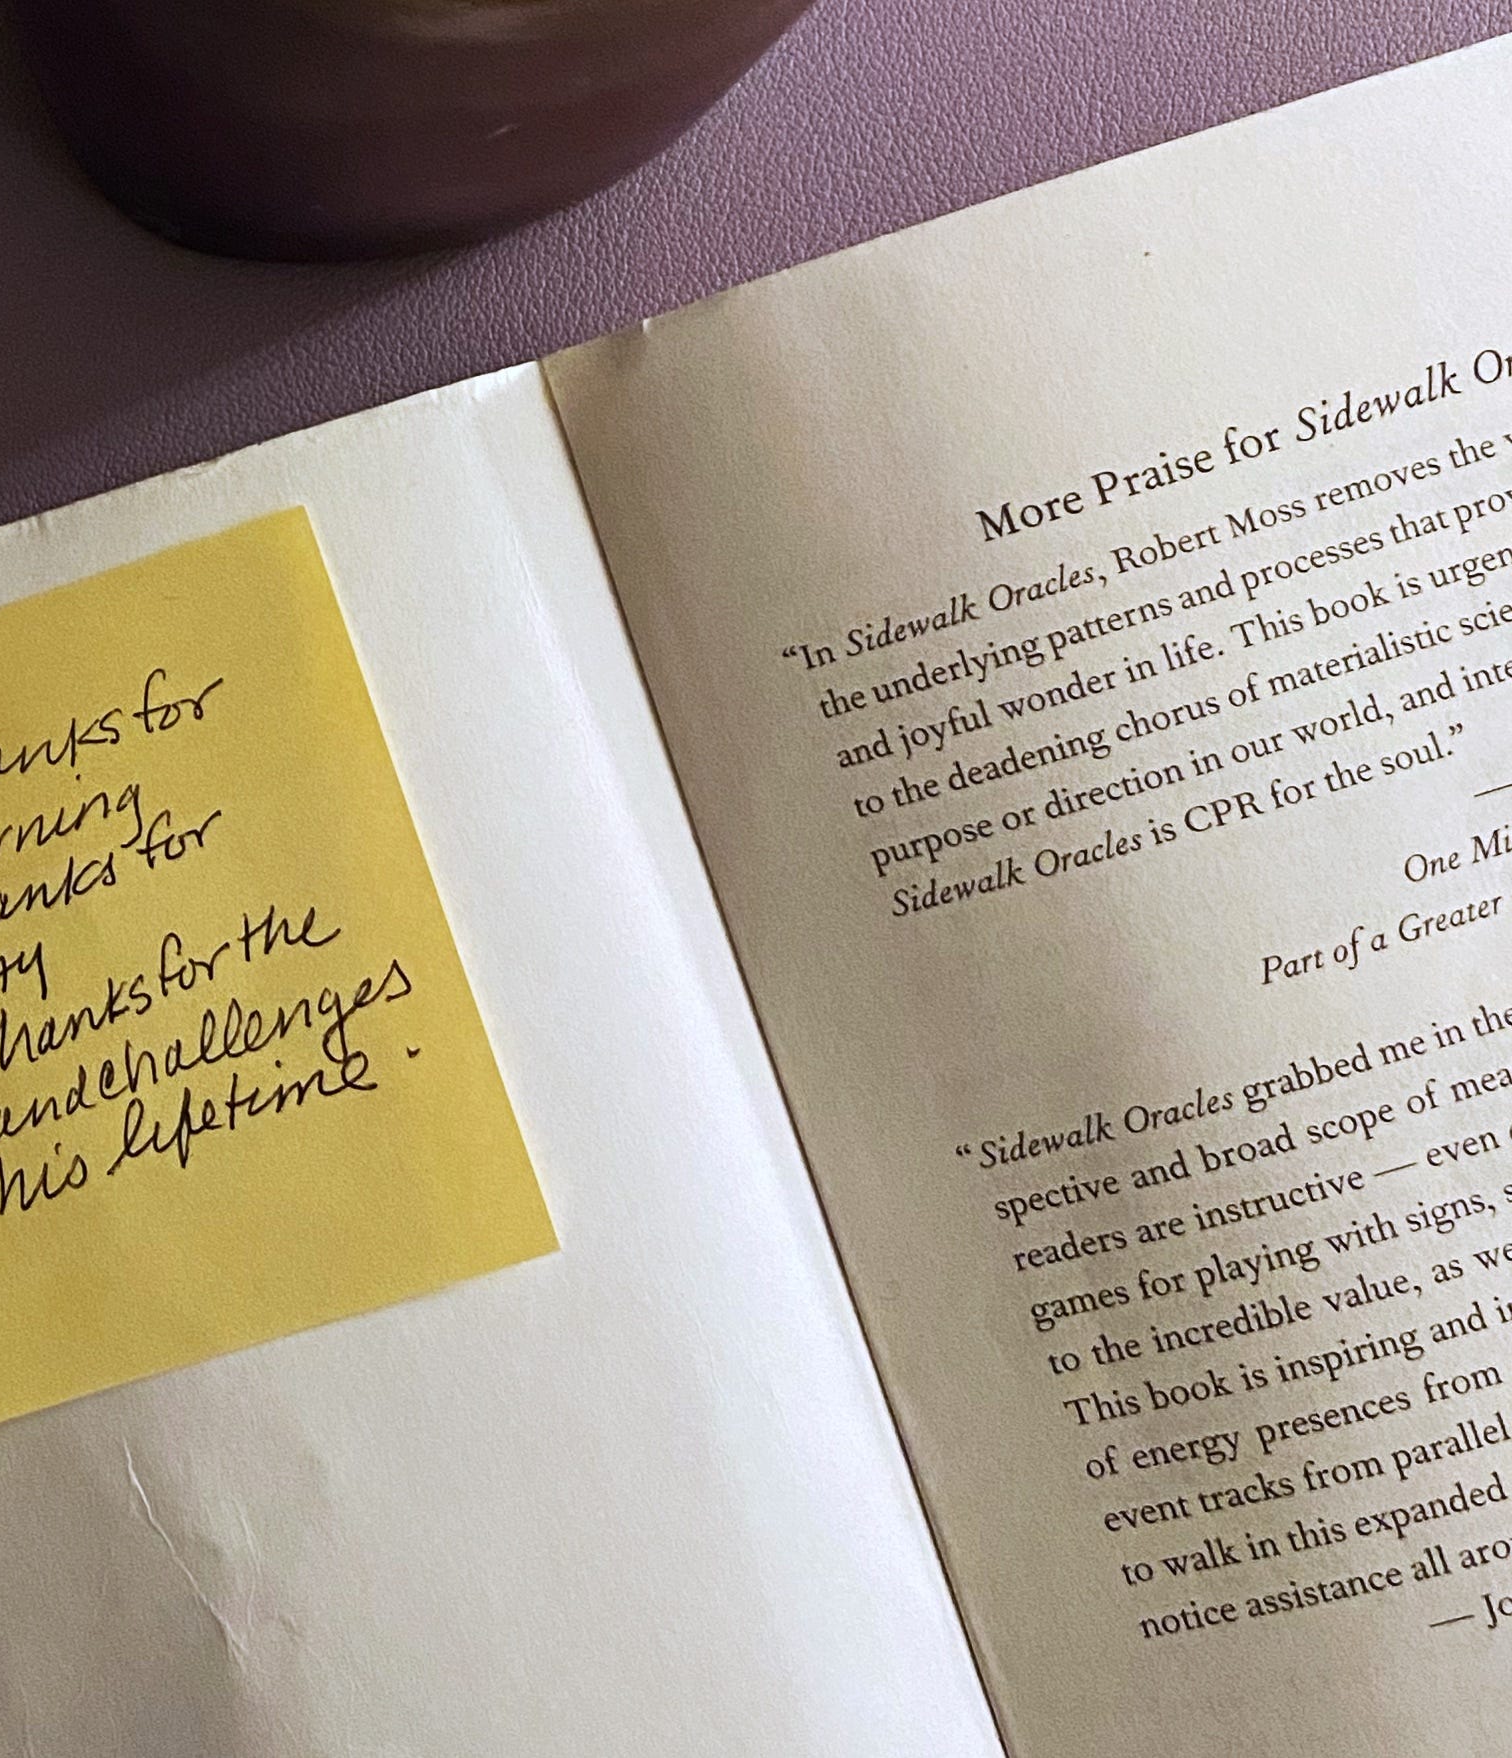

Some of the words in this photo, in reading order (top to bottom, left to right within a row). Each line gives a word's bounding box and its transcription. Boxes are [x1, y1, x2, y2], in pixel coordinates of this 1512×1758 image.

[974, 491, 1085, 543] More
[1090, 450, 1215, 506] Praise
[1223, 426, 1281, 465] for
[1295, 360, 1462, 442] Sidewalk
[845, 592, 981, 657] Sidewalk
[988, 562, 1108, 612] Oracles,
[1109, 525, 1222, 575] Robert
[1224, 499, 1307, 539] Moss
[1313, 457, 1442, 512] removes
[1448, 437, 1497, 469] the
[818, 688, 868, 720] the
[870, 636, 1046, 704] underlying
[1045, 598, 1173, 662] patterns
[1177, 568, 1237, 610] and
[1240, 532, 1385, 602] processes
[1389, 510, 1451, 545] that
[836, 727, 895, 769] and
[897, 698, 993, 761] joyful
[996, 669, 1117, 720] wonder
[1123, 656, 1159, 684] in
[1159, 633, 1225, 672] life.
[1229, 609, 1305, 649] This
[1305, 580, 1391, 627] book
[1394, 572, 1422, 599] is
[134, 669, 223, 733] for
[853, 795, 885, 819] to
[891, 775, 942, 808] the
[947, 728, 1112, 791] deadening
[1115, 696, 1221, 743] chorus
[1228, 671, 1261, 708] of
[1267, 620, 1453, 697] materialistic
[869, 819, 995, 878] purpose
[1001, 806, 1037, 831] or
[1044, 764, 1186, 820] direction
[1188, 749, 1225, 777] in
[1231, 732, 1284, 764] our
[1290, 692, 1395, 745] world,
[1399, 669, 1457, 712] and
[136, 809, 222, 869] for
[891, 856, 1027, 918] Sidewalk
[1034, 828, 1142, 878] Oracles
[1147, 818, 1178, 847] is
[1183, 791, 1265, 833] CPR
[1270, 778, 1317, 810] for
[1323, 760, 1374, 793] the
[1404, 851, 1461, 883] One
[160, 932, 230, 997] for
[228, 906, 341, 964] the
[1261, 949, 1325, 986] Part
[1333, 925, 1365, 971] of
[1370, 932, 1389, 952] a
[1398, 895, 1503, 942] Greater
[1123, 1086, 1234, 1134] Oracles
[1242, 1041, 1374, 1114] grabbed
[1378, 1036, 1428, 1066] me
[1431, 1022, 1467, 1049] in
[1471, 1004, 1512, 1037] the
[994, 1174, 1121, 1228] spective
[1130, 1148, 1193, 1190] and
[1194, 1121, 1298, 1174] broad
[1306, 1104, 1396, 1145] scope
[1406, 1078, 1440, 1115] of
[1012, 1229, 1128, 1273] readers
[1135, 1217, 1187, 1244] are
[1192, 1171, 1365, 1232] instructive
[1426, 1131, 1501, 1167] even
[1030, 1285, 1131, 1334] games
[1137, 1268, 1187, 1302] for
[1193, 1240, 1321, 1300] playing
[1323, 1211, 1400, 1254] with
[1405, 1194, 1497, 1235] signs,
[1047, 1352, 1082, 1376] to
[1090, 1333, 1143, 1366] the
[1149, 1294, 1313, 1354] incredible
[1321, 1273, 1423, 1313] value,
[1431, 1259, 1464, 1284] as
[1062, 1389, 1142, 1427] This
[1142, 1369, 1235, 1411] book
[1238, 1363, 1269, 1393] is
[1273, 1328, 1426, 1384] inspiring
[1429, 1300, 1489, 1344] and
[1085, 1444, 1120, 1481] of
[1132, 1430, 1240, 1470] energy
[1254, 1391, 1412, 1457] presences
[1423, 1366, 1504, 1404] from
[1103, 1495, 1193, 1533] event
[1197, 1471, 1296, 1514] tracks
[1302, 1457, 1386, 1493] from
[1390, 1411, 1512, 1483] parallel
[1120, 1562, 1154, 1587] to
[1159, 1536, 1243, 1577] walk
[1244, 1531, 1282, 1561] in
[1286, 1517, 1348, 1553] this
[1354, 1470, 1509, 1541] expanded
[1138, 1600, 1240, 1640] notice
[1245, 1567, 1404, 1619] assistance
[1410, 1544, 1453, 1582] all
[1458, 1537, 1512, 1571] aro
